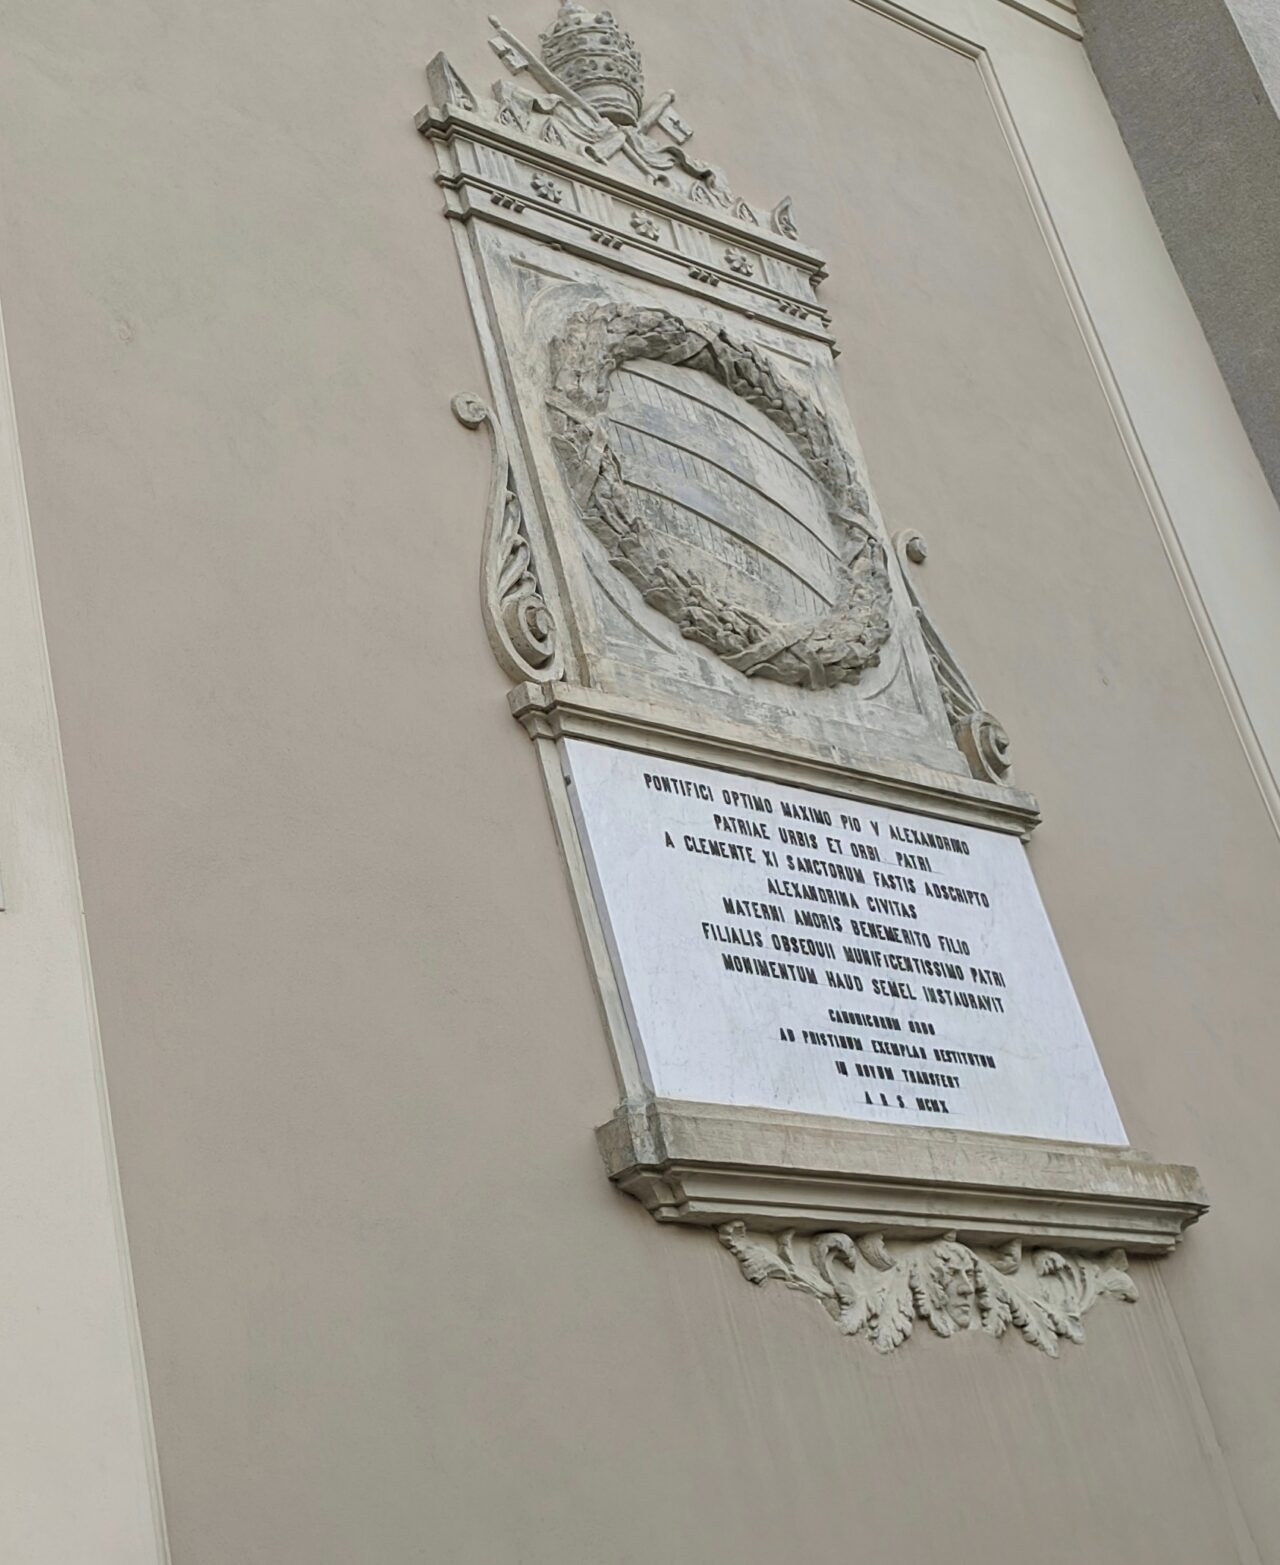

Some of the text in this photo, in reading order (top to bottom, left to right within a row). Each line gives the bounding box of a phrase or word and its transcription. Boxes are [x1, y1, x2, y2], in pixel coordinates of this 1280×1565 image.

[643, 772, 970, 855] PONTIFICI OPTIMO MAXIMO PIO V ALEXANDRINO
[713, 813, 932, 873] PATRIAE URBIS ET ORBI PATRI
[664, 831, 990, 908] A CLEMENTE XI SANCTORUM FASTIS ADSCRIPTO
[767, 878, 918, 919] ALEXANDRINA CIVITAS
[701, 922, 764, 948] FILIALIS
[842, 945, 965, 981] MUNIFICENTISSIMO
[970, 967, 1006, 988] PATRI
[722, 896, 970, 956] MATERNI AMORIS BENEMERITO FILIO
[721, 953, 1004, 1013] MONIMENTUM HAUD SEMEL INSTAURAVIT
[779, 1027, 796, 1042] AD
